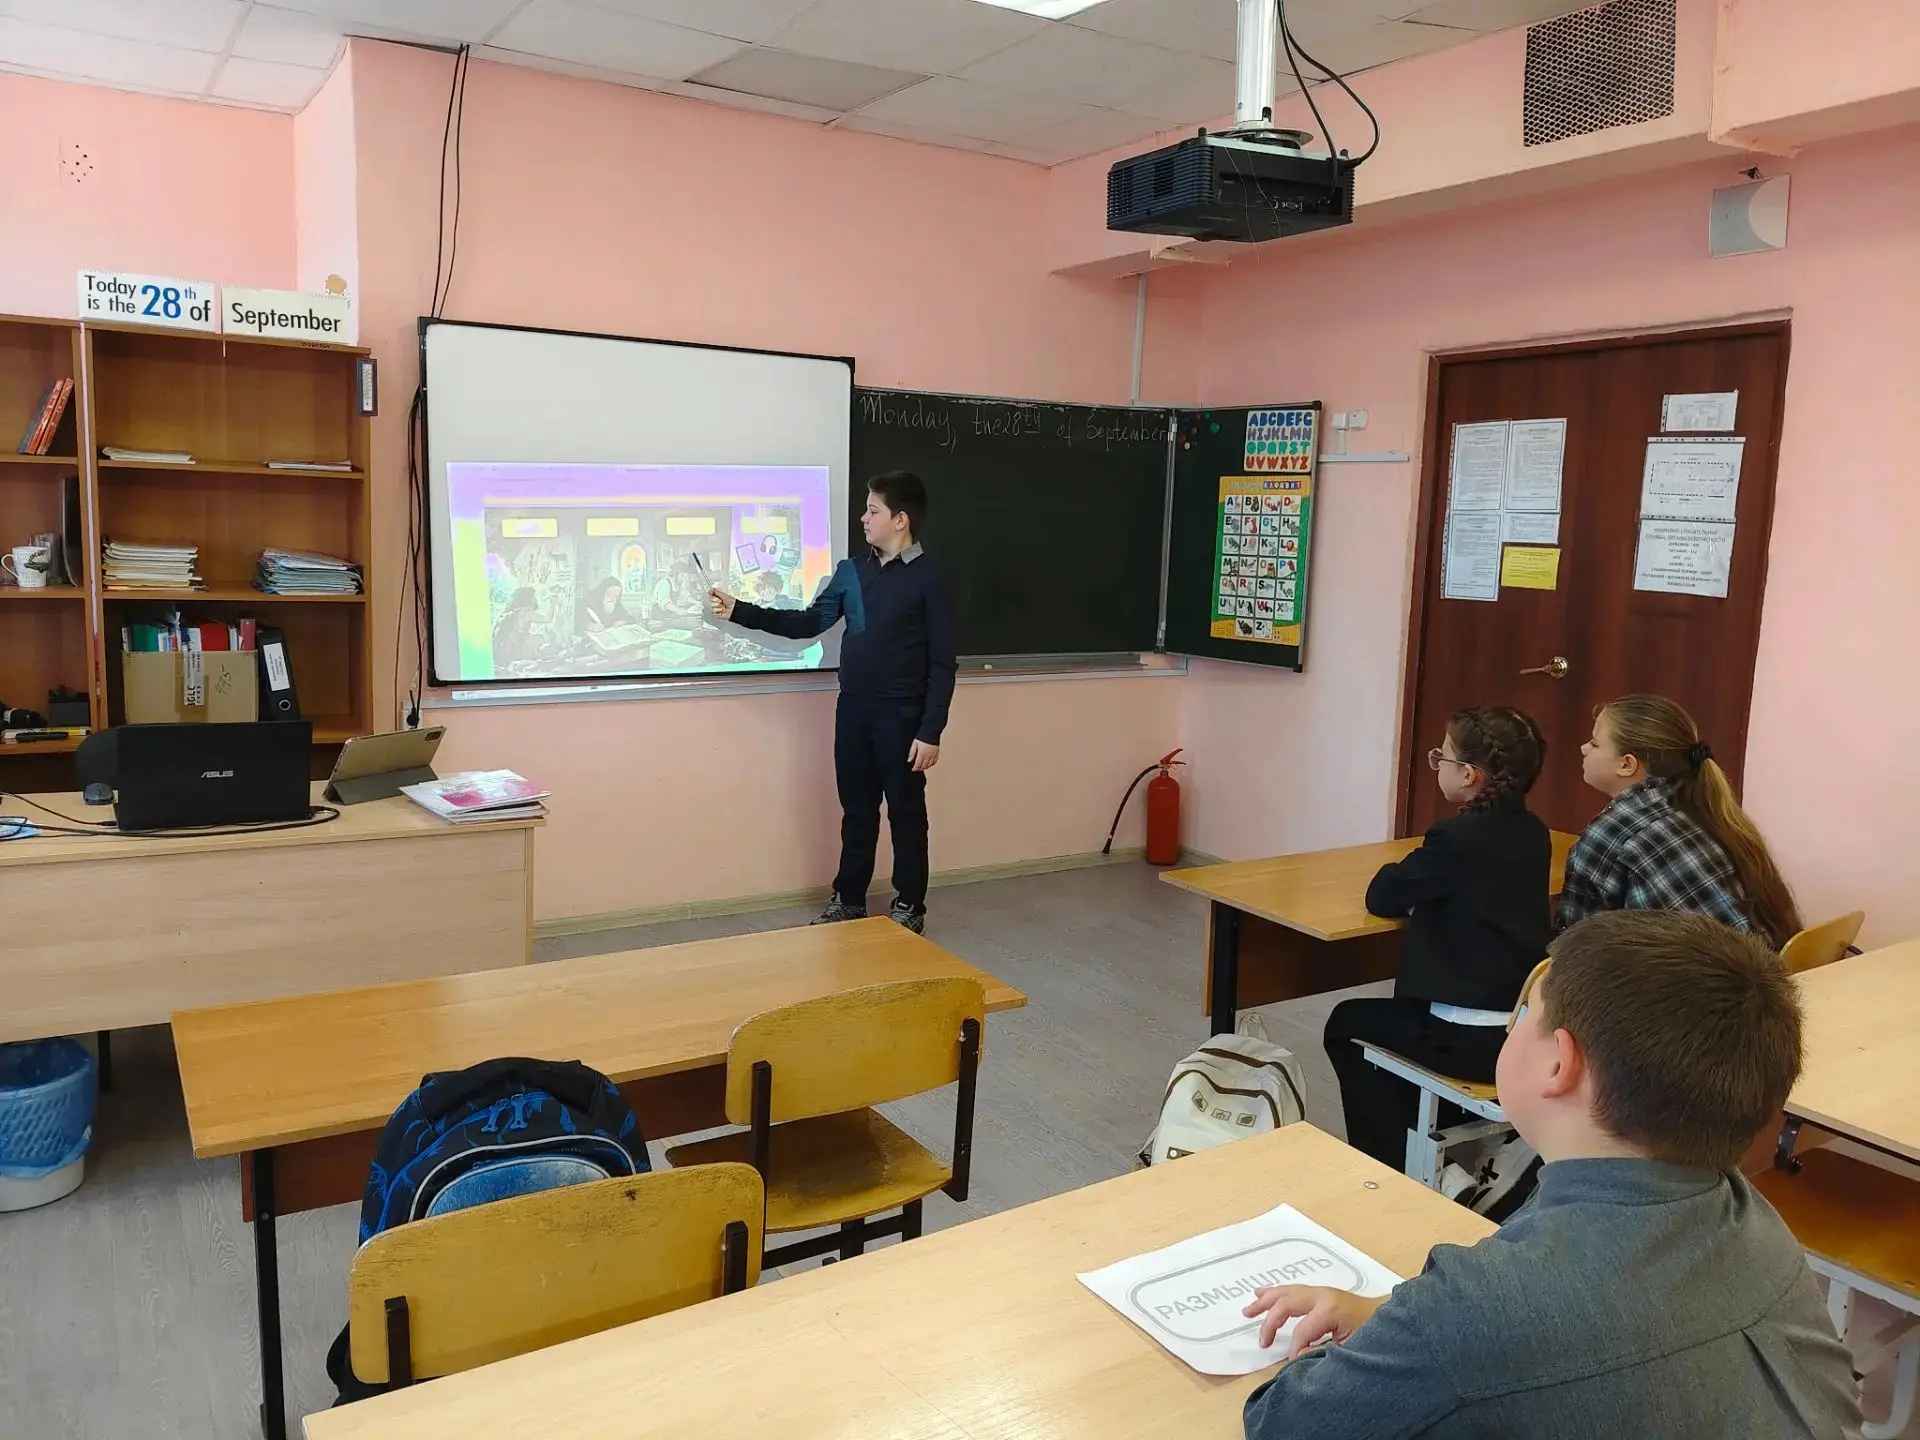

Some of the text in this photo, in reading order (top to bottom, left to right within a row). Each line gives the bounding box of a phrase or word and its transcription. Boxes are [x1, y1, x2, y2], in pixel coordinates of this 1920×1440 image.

[84, 274, 137, 299] Today
[87, 296, 100, 310] is
[109, 296, 136, 314] the
[190, 300, 211, 322] of
[231, 302, 341, 333] September
[860, 395, 957, 454] Monday,
[1086, 412, 1167, 451] September
[1227, 497, 1233, 505] A
[1245, 497, 1252, 505] B
[1284, 497, 1290, 506] D
[1226, 516, 1232, 525] E
[1244, 517, 1250, 525] F
[1263, 518, 1269, 526] G
[1283, 518, 1289, 527] H
[1243, 538, 1247, 546] J
[1262, 539, 1268, 547] K
[1281, 539, 1286, 548] L
[1224, 558, 1231, 566] M
[1241, 559, 1247, 567] N
[1261, 560, 1266, 568] O
[1280, 561, 1286, 569] P
[1240, 579, 1246, 587] R
[1259, 580, 1264, 589] S
[1220, 598, 1226, 606] U
[1238, 600, 1244, 608] V
[1277, 603, 1284, 612] X
[1256, 622, 1262, 630] Z
[200, 770, 234, 779] ASUS
[1154, 1256, 1334, 1320] РАЗМЫШЛЯТЬ
